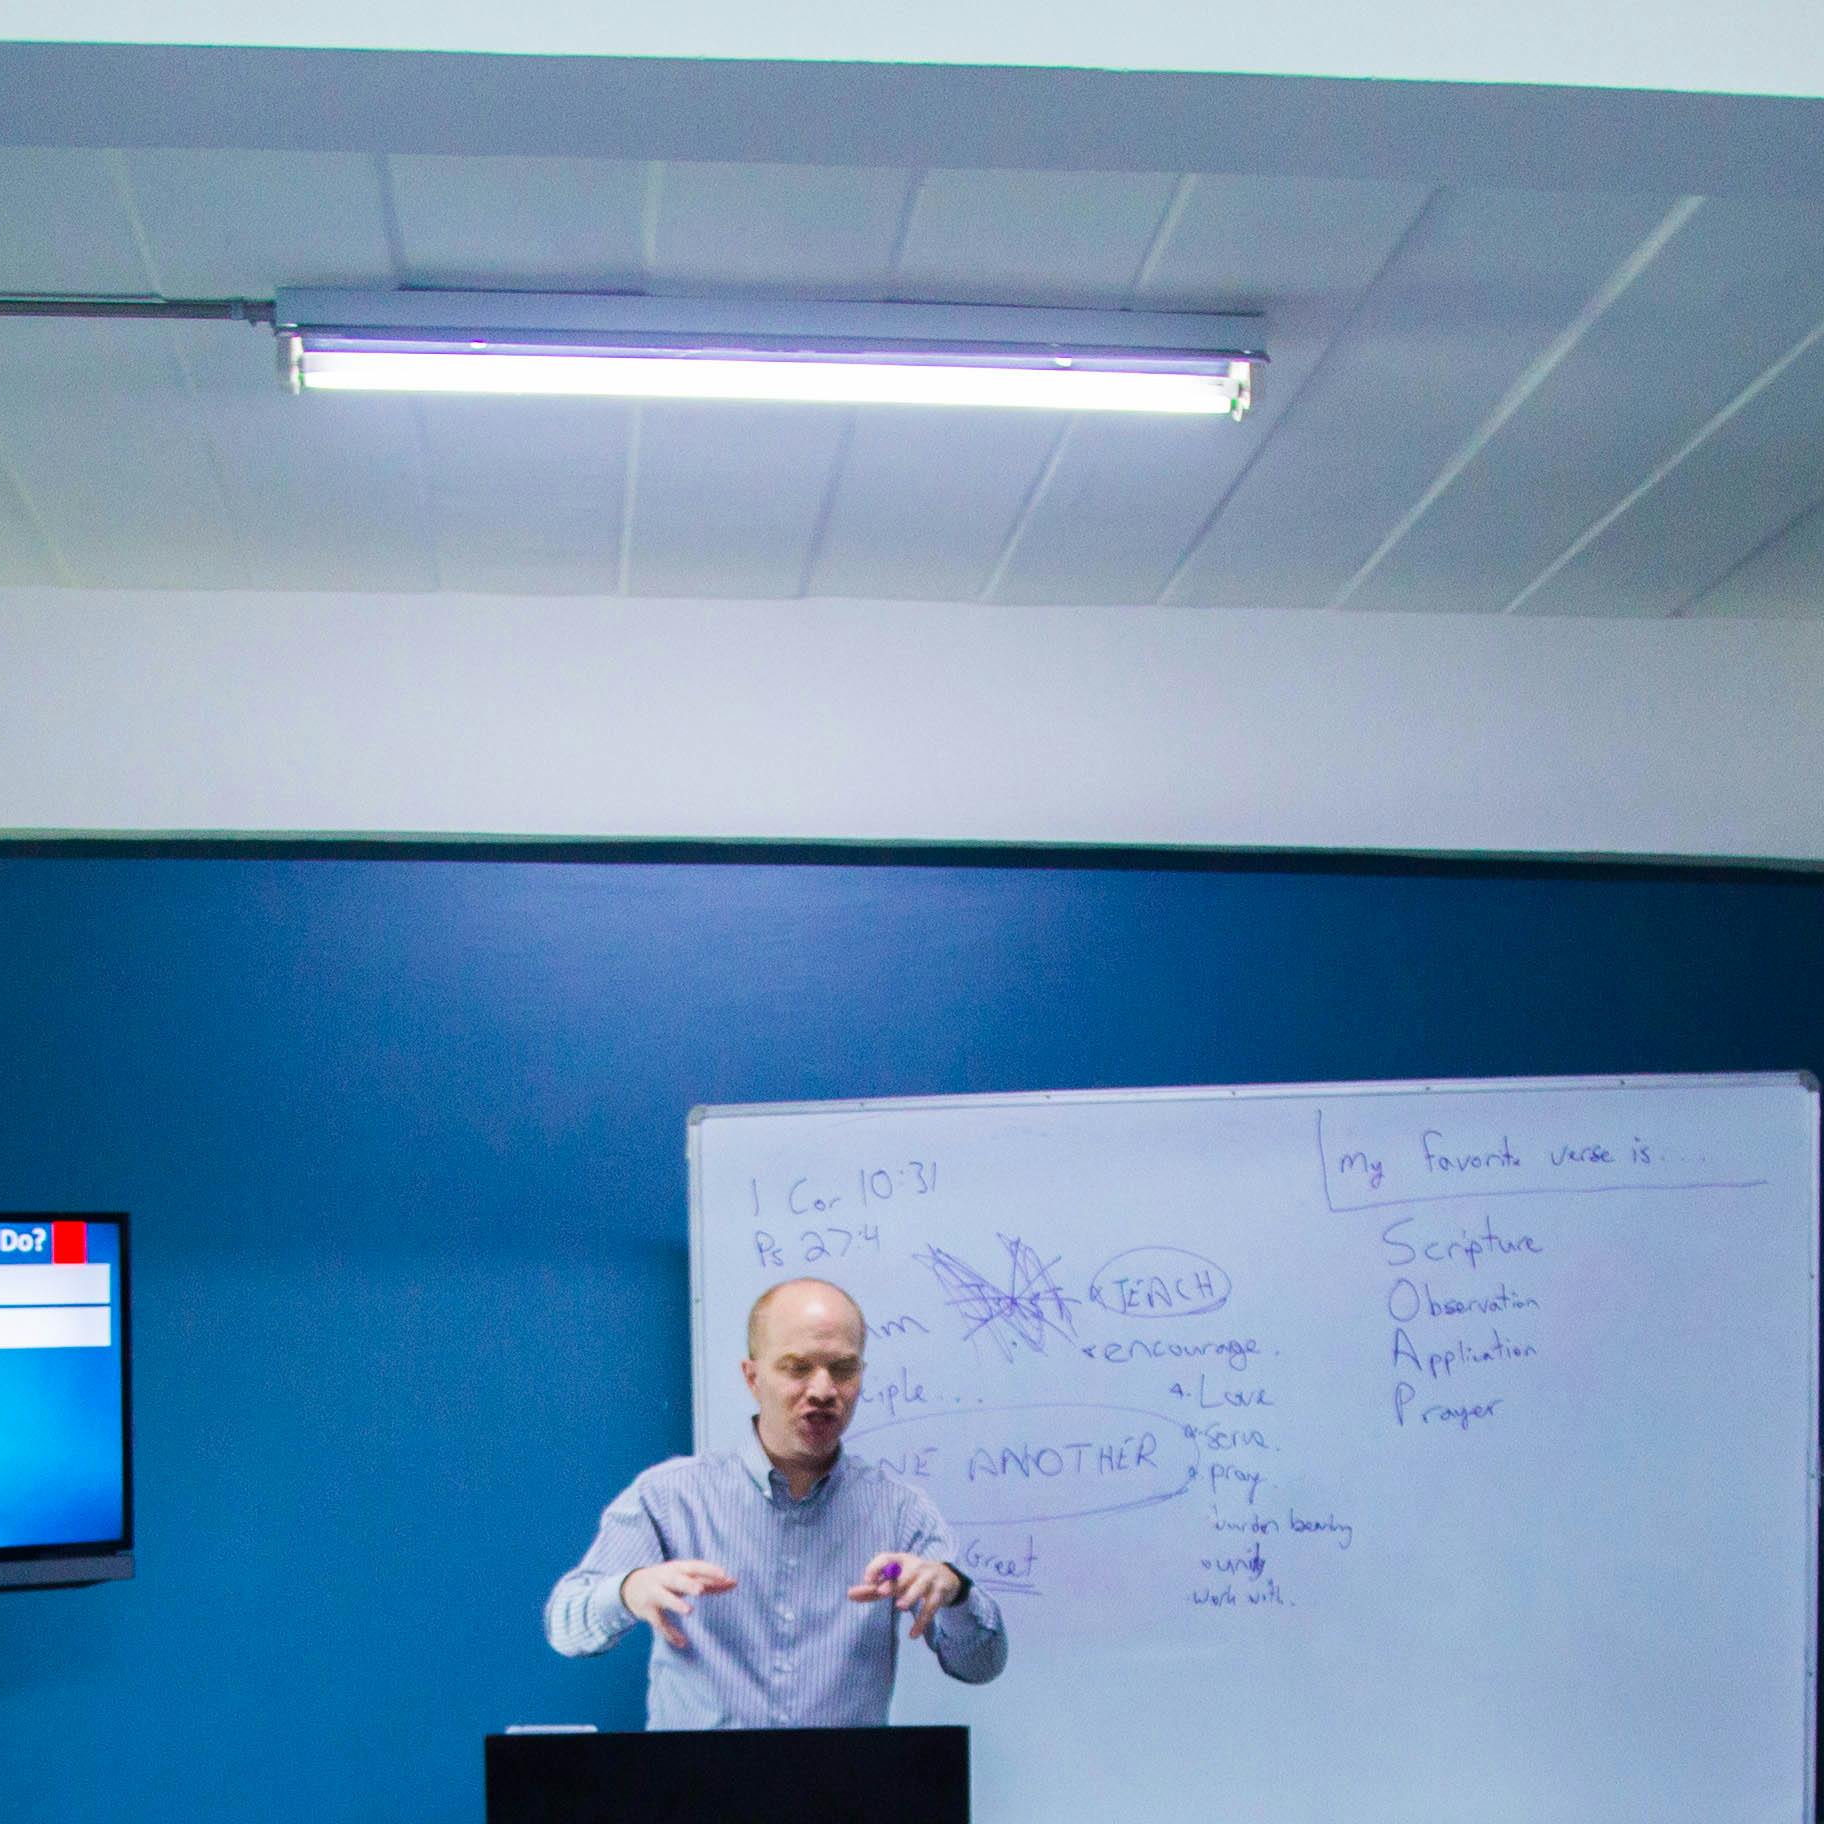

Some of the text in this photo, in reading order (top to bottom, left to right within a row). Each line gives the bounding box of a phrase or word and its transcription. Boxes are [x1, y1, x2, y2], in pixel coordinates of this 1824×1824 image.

[1551, 1142, 1615, 1168] verse
[788, 1176, 842, 1216] Cor
[859, 1160, 938, 1209] 10:31
[754, 1222, 882, 1268] Ps 27:4
[1381, 1215, 1544, 1269] Scripture
[1111, 1268, 1215, 1315] TEACH
[1388, 1277, 1541, 1323] Observation
[1103, 1339, 1261, 1372] encourage
[1393, 1327, 1537, 1379] Application
[1394, 1381, 1505, 1431] Prayer
[878, 1432, 1158, 1482] NE ANOTHER
[964, 1535, 1039, 1578] Greet
